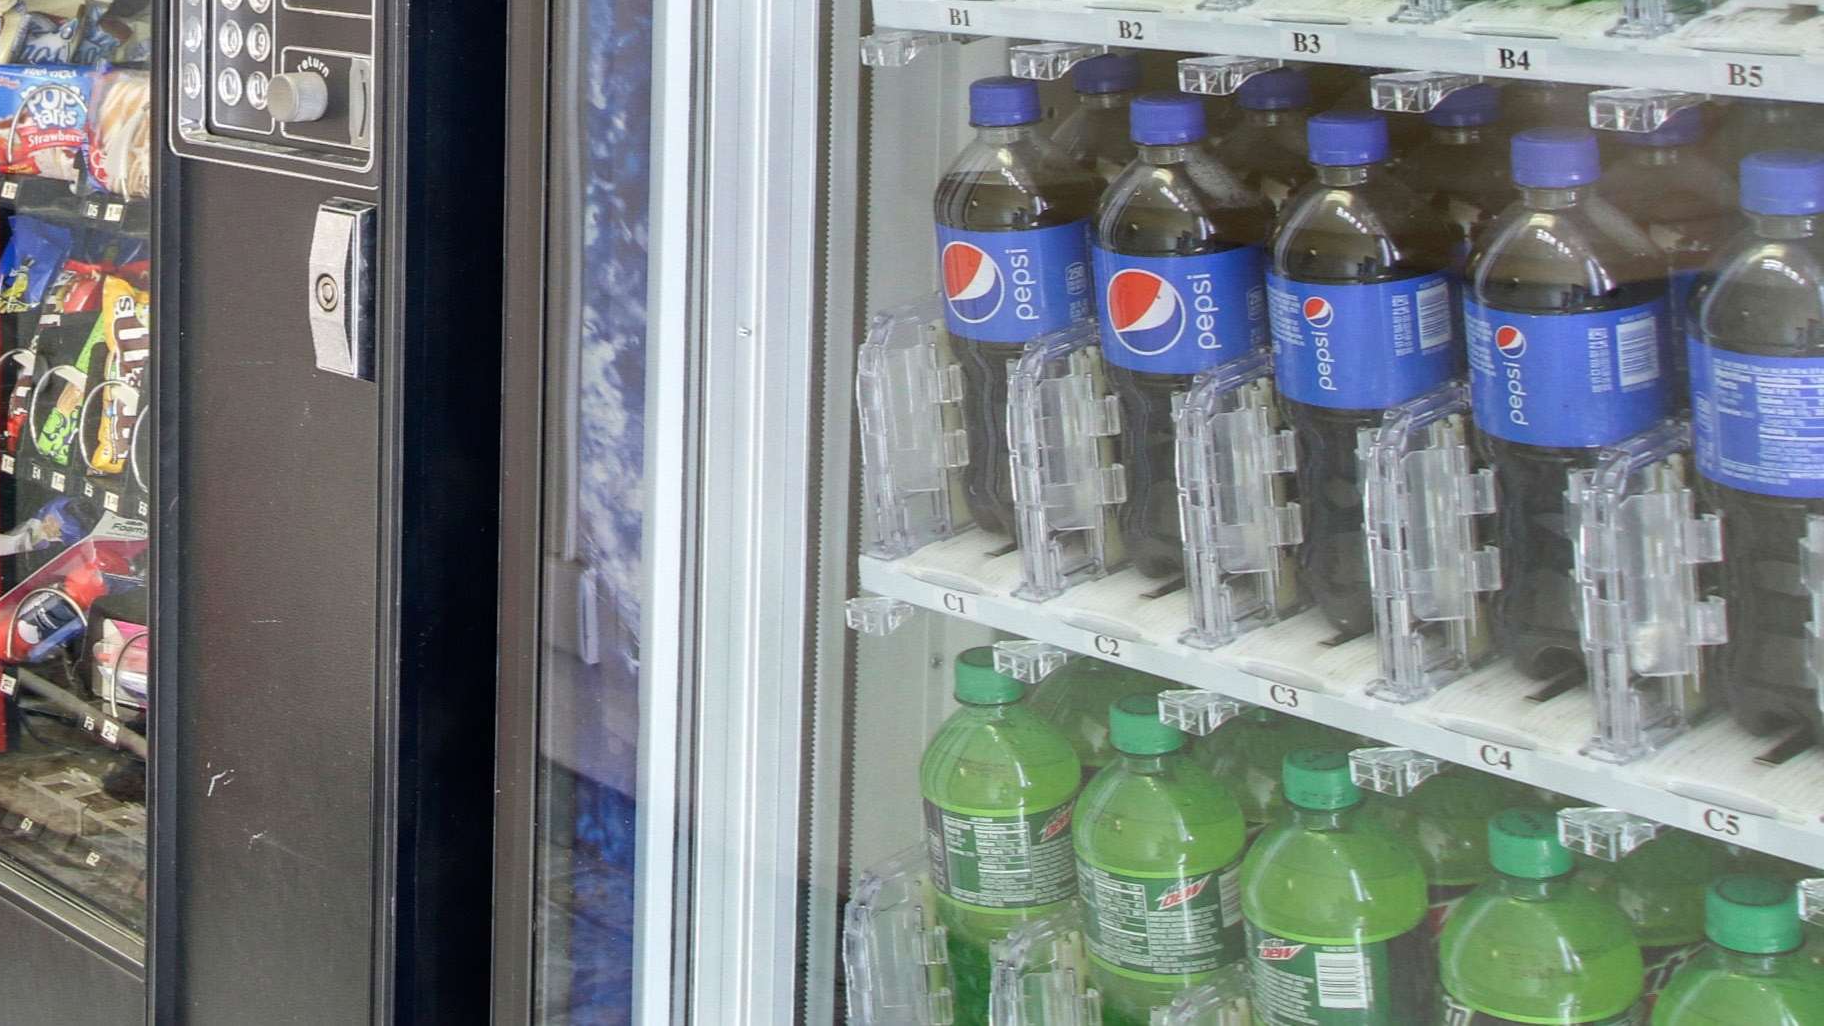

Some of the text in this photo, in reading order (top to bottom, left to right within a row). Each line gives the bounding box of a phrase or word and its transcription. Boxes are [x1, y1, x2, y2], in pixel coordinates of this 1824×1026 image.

[949, 8, 972, 27] B1
[1118, 20, 1144, 40] B2
[1292, 32, 1321, 54] B3
[296, 56, 330, 77] return
[1498, 47, 1531, 71] B4
[1727, 63, 1764, 87] B5
[28, 131, 82, 147] Strawberr
[1005, 248, 1039, 321] pepsi
[1186, 273, 1222, 350] pepsi
[1311, 331, 1338, 391] pepsi
[1503, 361, 1530, 426] pepsi
[943, 592, 966, 614] C1
[1094, 634, 1121, 658] C2
[1270, 684, 1298, 708] C3
[1480, 744, 1513, 771] C4
[1704, 808, 1740, 836] C5
